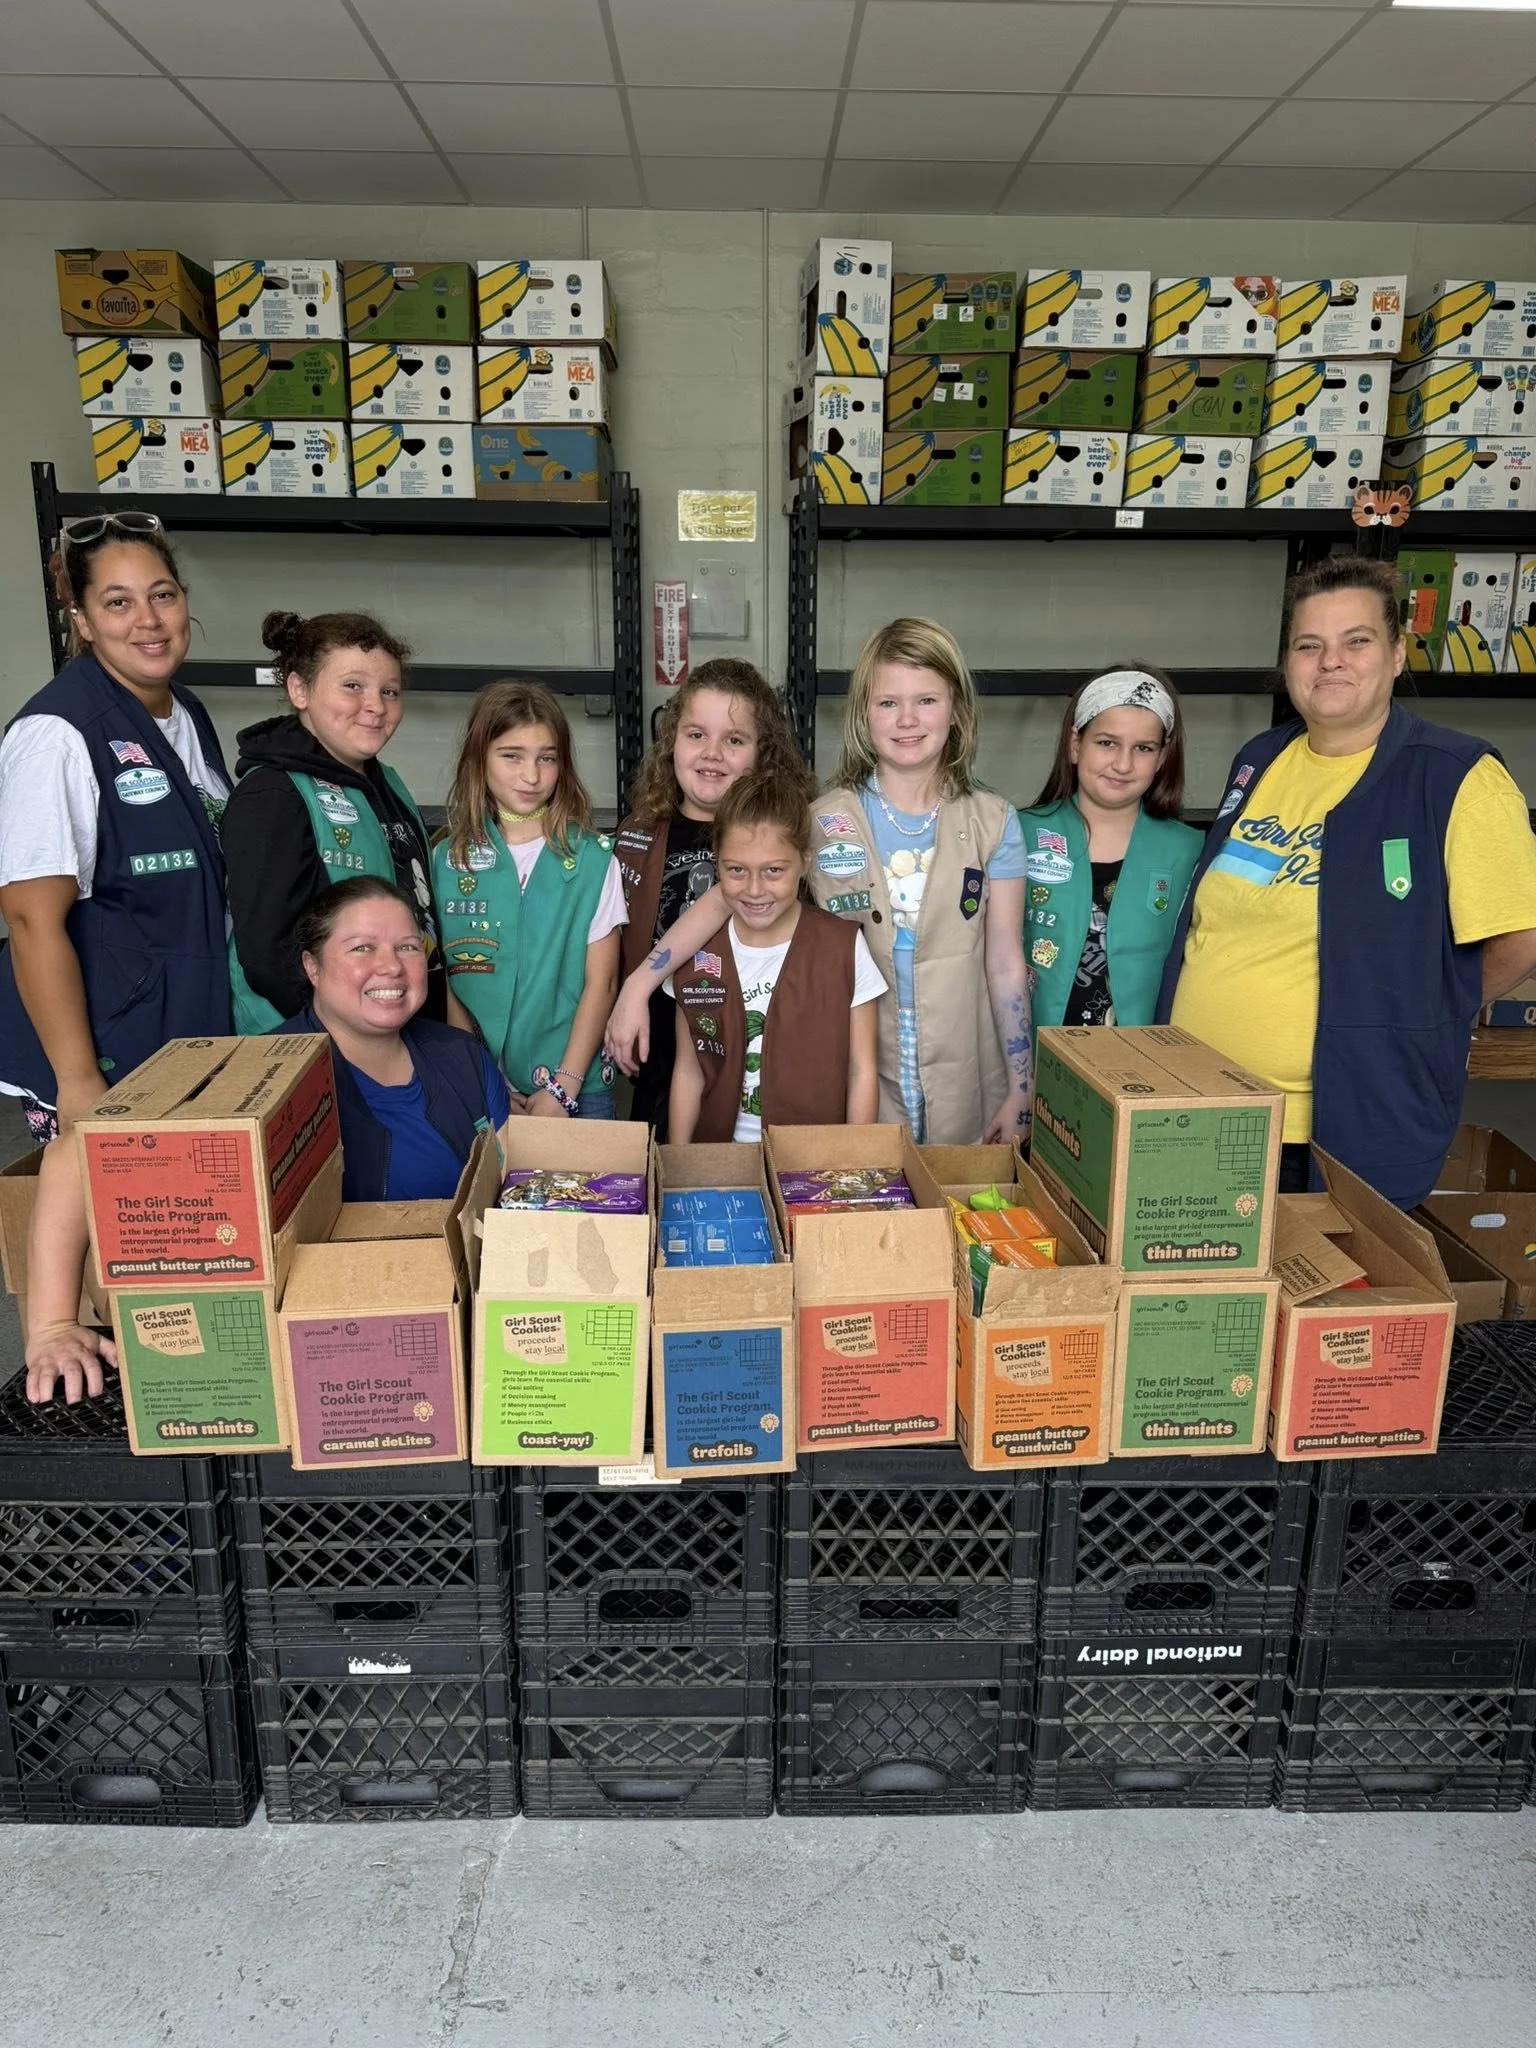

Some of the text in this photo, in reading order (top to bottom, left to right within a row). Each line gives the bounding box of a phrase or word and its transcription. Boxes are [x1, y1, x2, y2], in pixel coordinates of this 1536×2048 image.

[100, 298, 137, 315] favorita
[480, 435, 509, 449] One
[1087, 446, 1104, 454] best
[1504, 450, 1531, 459] change
[657, 588, 684, 603] FIRE
[129, 778, 152, 787] SCOUTS
[121, 786, 166, 798] GATEWAY COUNCIL
[1239, 815, 1300, 848] Girl
[134, 852, 195, 872] 02132
[323, 850, 364, 870] 2132
[1038, 859, 1059, 868] SCOUTS
[621, 863, 641, 885] 2132
[1047, 870, 1067, 878] COUNCIL
[446, 902, 487, 913] 2132
[830, 894, 869, 911] 2132
[743, 986, 763, 1003] Girl
[697, 1039, 725, 1056] 2132
[1036, 1095, 1081, 1160] thin mints
[116, 1196, 214, 1209] The Girl Scout
[1138, 1196, 1218, 1207] The Girl Scout
[118, 1211, 165, 1224] Cookie
[1136, 1209, 1176, 1220] Cookie
[143, 1228, 169, 1237] largest
[171, 1227, 200, 1236] girl-led
[120, 1236, 216, 1247] entrepreneurial program
[145, 1246, 170, 1254] world.
[1146, 1243, 1238, 1260] thin mints
[112, 1258, 252, 1274] peanut butter patties
[1290, 1258, 1320, 1285] Perishable
[135, 1308, 191, 1322] Girl Scout
[505, 1315, 561, 1327] Girl Scout
[824, 1316, 872, 1330] Girl Scout
[151, 1328, 189, 1340] proceeds
[835, 1333, 868, 1345] proceeds
[1322, 1329, 1370, 1341] Girl Scout
[160, 1336, 200, 1348] stay local
[518, 1335, 556, 1346] proceeds
[841, 1341, 876, 1352] stay local
[524, 1344, 565, 1356] stay local
[994, 1341, 1046, 1355] Girl Scout
[1331, 1346, 1364, 1358] proceeds
[1353, 1353, 1371, 1364] local
[1006, 1361, 1041, 1372] proceeds
[1013, 1367, 1049, 1379] stay local
[319, 1377, 412, 1393] The Girl Scout
[1136, 1376, 1214, 1387] The Girl Scout
[677, 1391, 760, 1403] The Girl Scout
[1135, 1389, 1173, 1399] Cookie
[320, 1395, 366, 1406] Cookie
[344, 1409, 370, 1417] largest
[371, 1407, 398, 1416] girl-led
[677, 1404, 718, 1415] Cookie
[322, 1415, 414, 1427] entrepreneurial program
[160, 1421, 254, 1436] thin mints
[811, 1419, 935, 1438] peanut butter patties
[1145, 1422, 1233, 1436] thin mints
[522, 1435, 590, 1448] toast-yay!
[995, 1428, 1087, 1444] peanut butter
[1298, 1431, 1421, 1448] peanut butter patties
[323, 1435, 431, 1451] caramel deLites
[1009, 1442, 1072, 1454] sandwich
[692, 1444, 753, 1459] trefoils
[1076, 1644, 1243, 1666] national dairy
